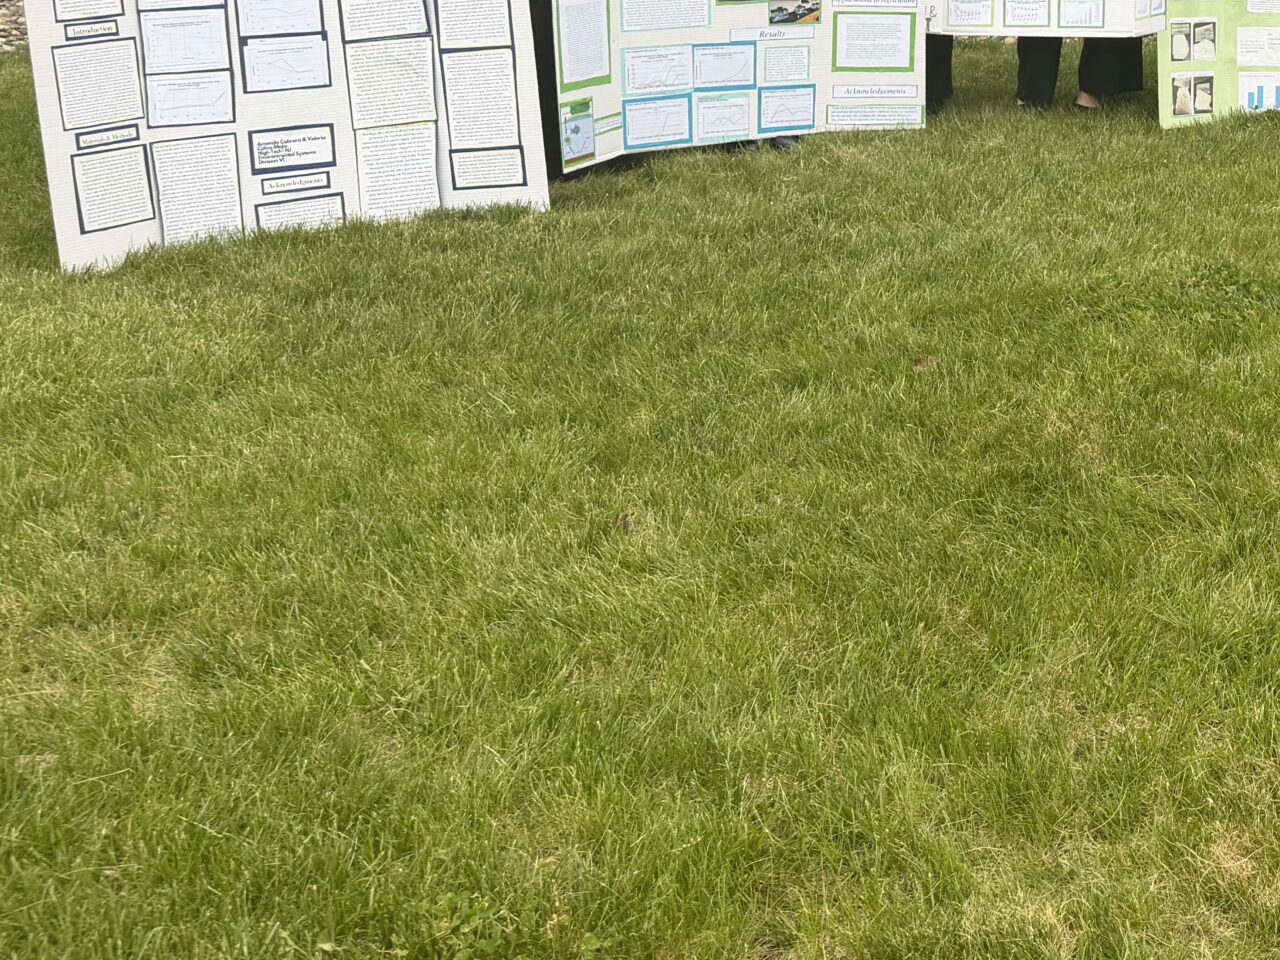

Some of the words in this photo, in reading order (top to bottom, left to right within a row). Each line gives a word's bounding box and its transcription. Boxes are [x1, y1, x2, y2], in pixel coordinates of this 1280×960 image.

[72, 26, 113, 36] Introduction
[759, 29, 787, 39] Results
[844, 87, 907, 96] Acknowledgements
[296, 149, 317, 158] Systems
